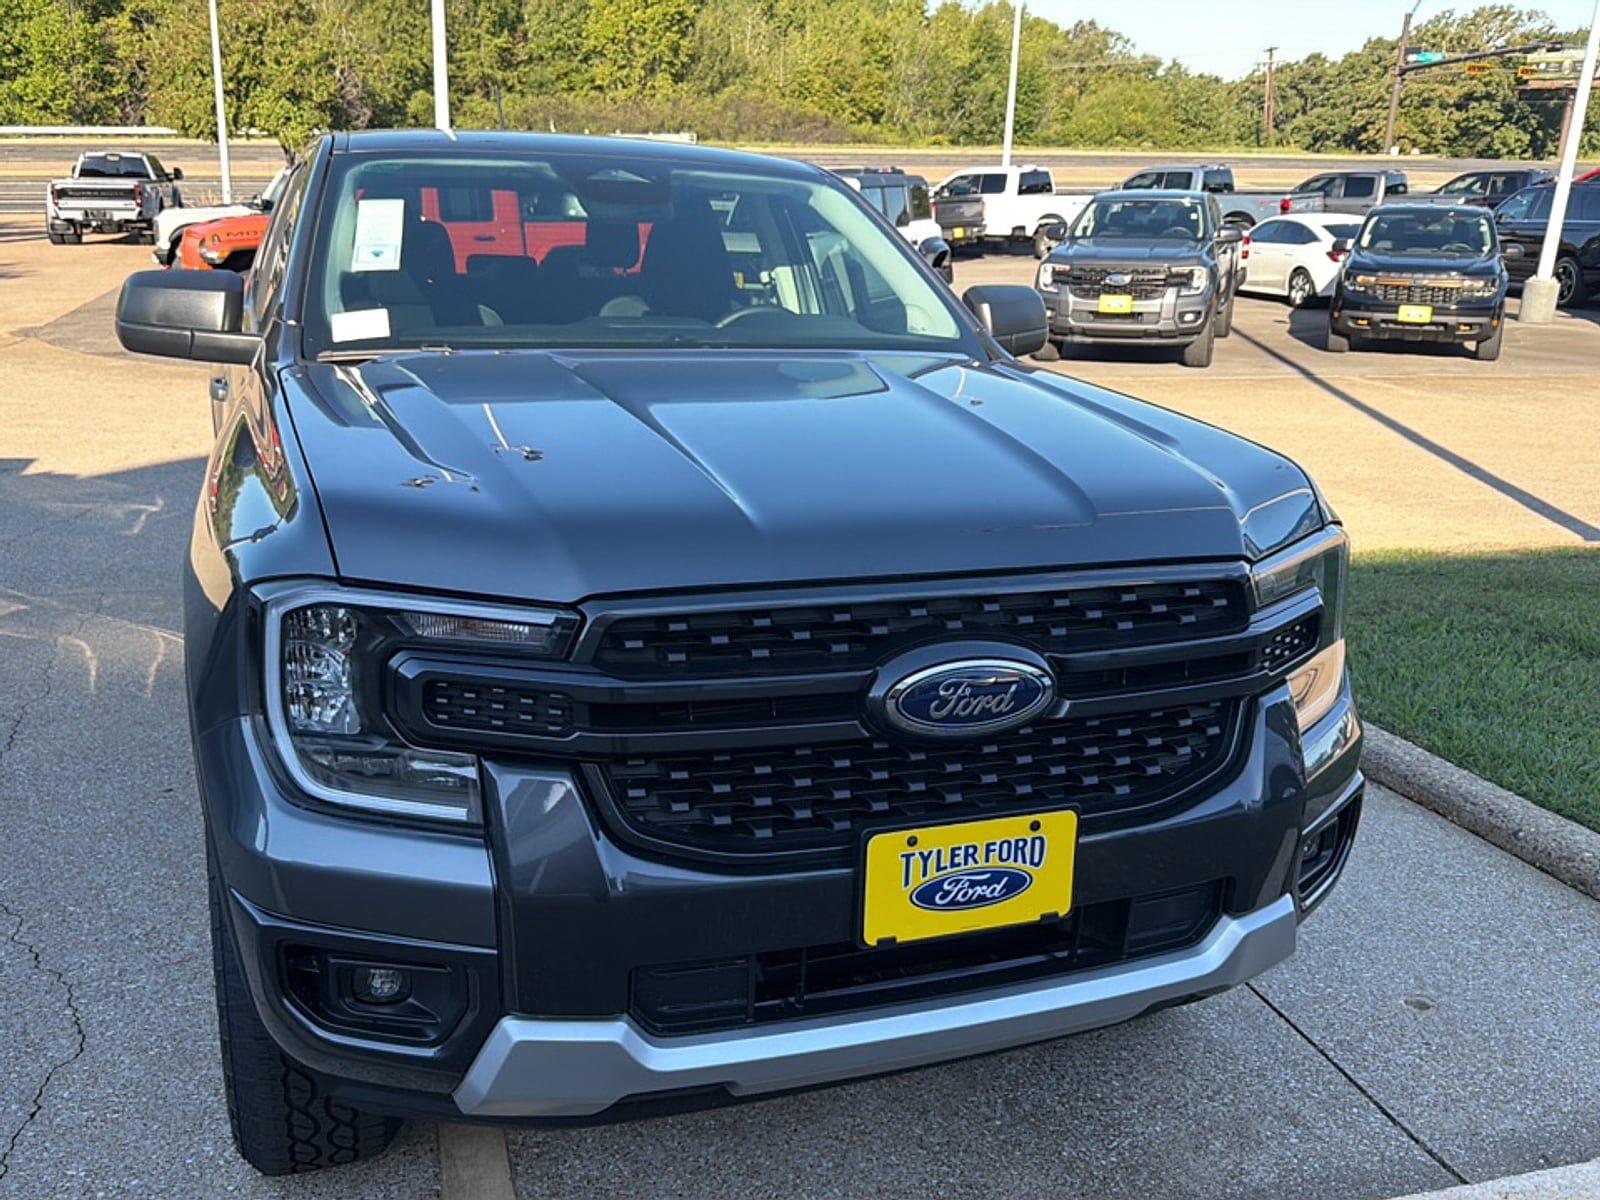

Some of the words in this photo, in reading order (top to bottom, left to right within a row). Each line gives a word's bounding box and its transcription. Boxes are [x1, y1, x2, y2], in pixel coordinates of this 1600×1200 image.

[929, 676, 1019, 719] Ford
[900, 843, 980, 889] TYLER
[984, 835, 1046, 868] FORD
[935, 873, 1009, 905] Ford
